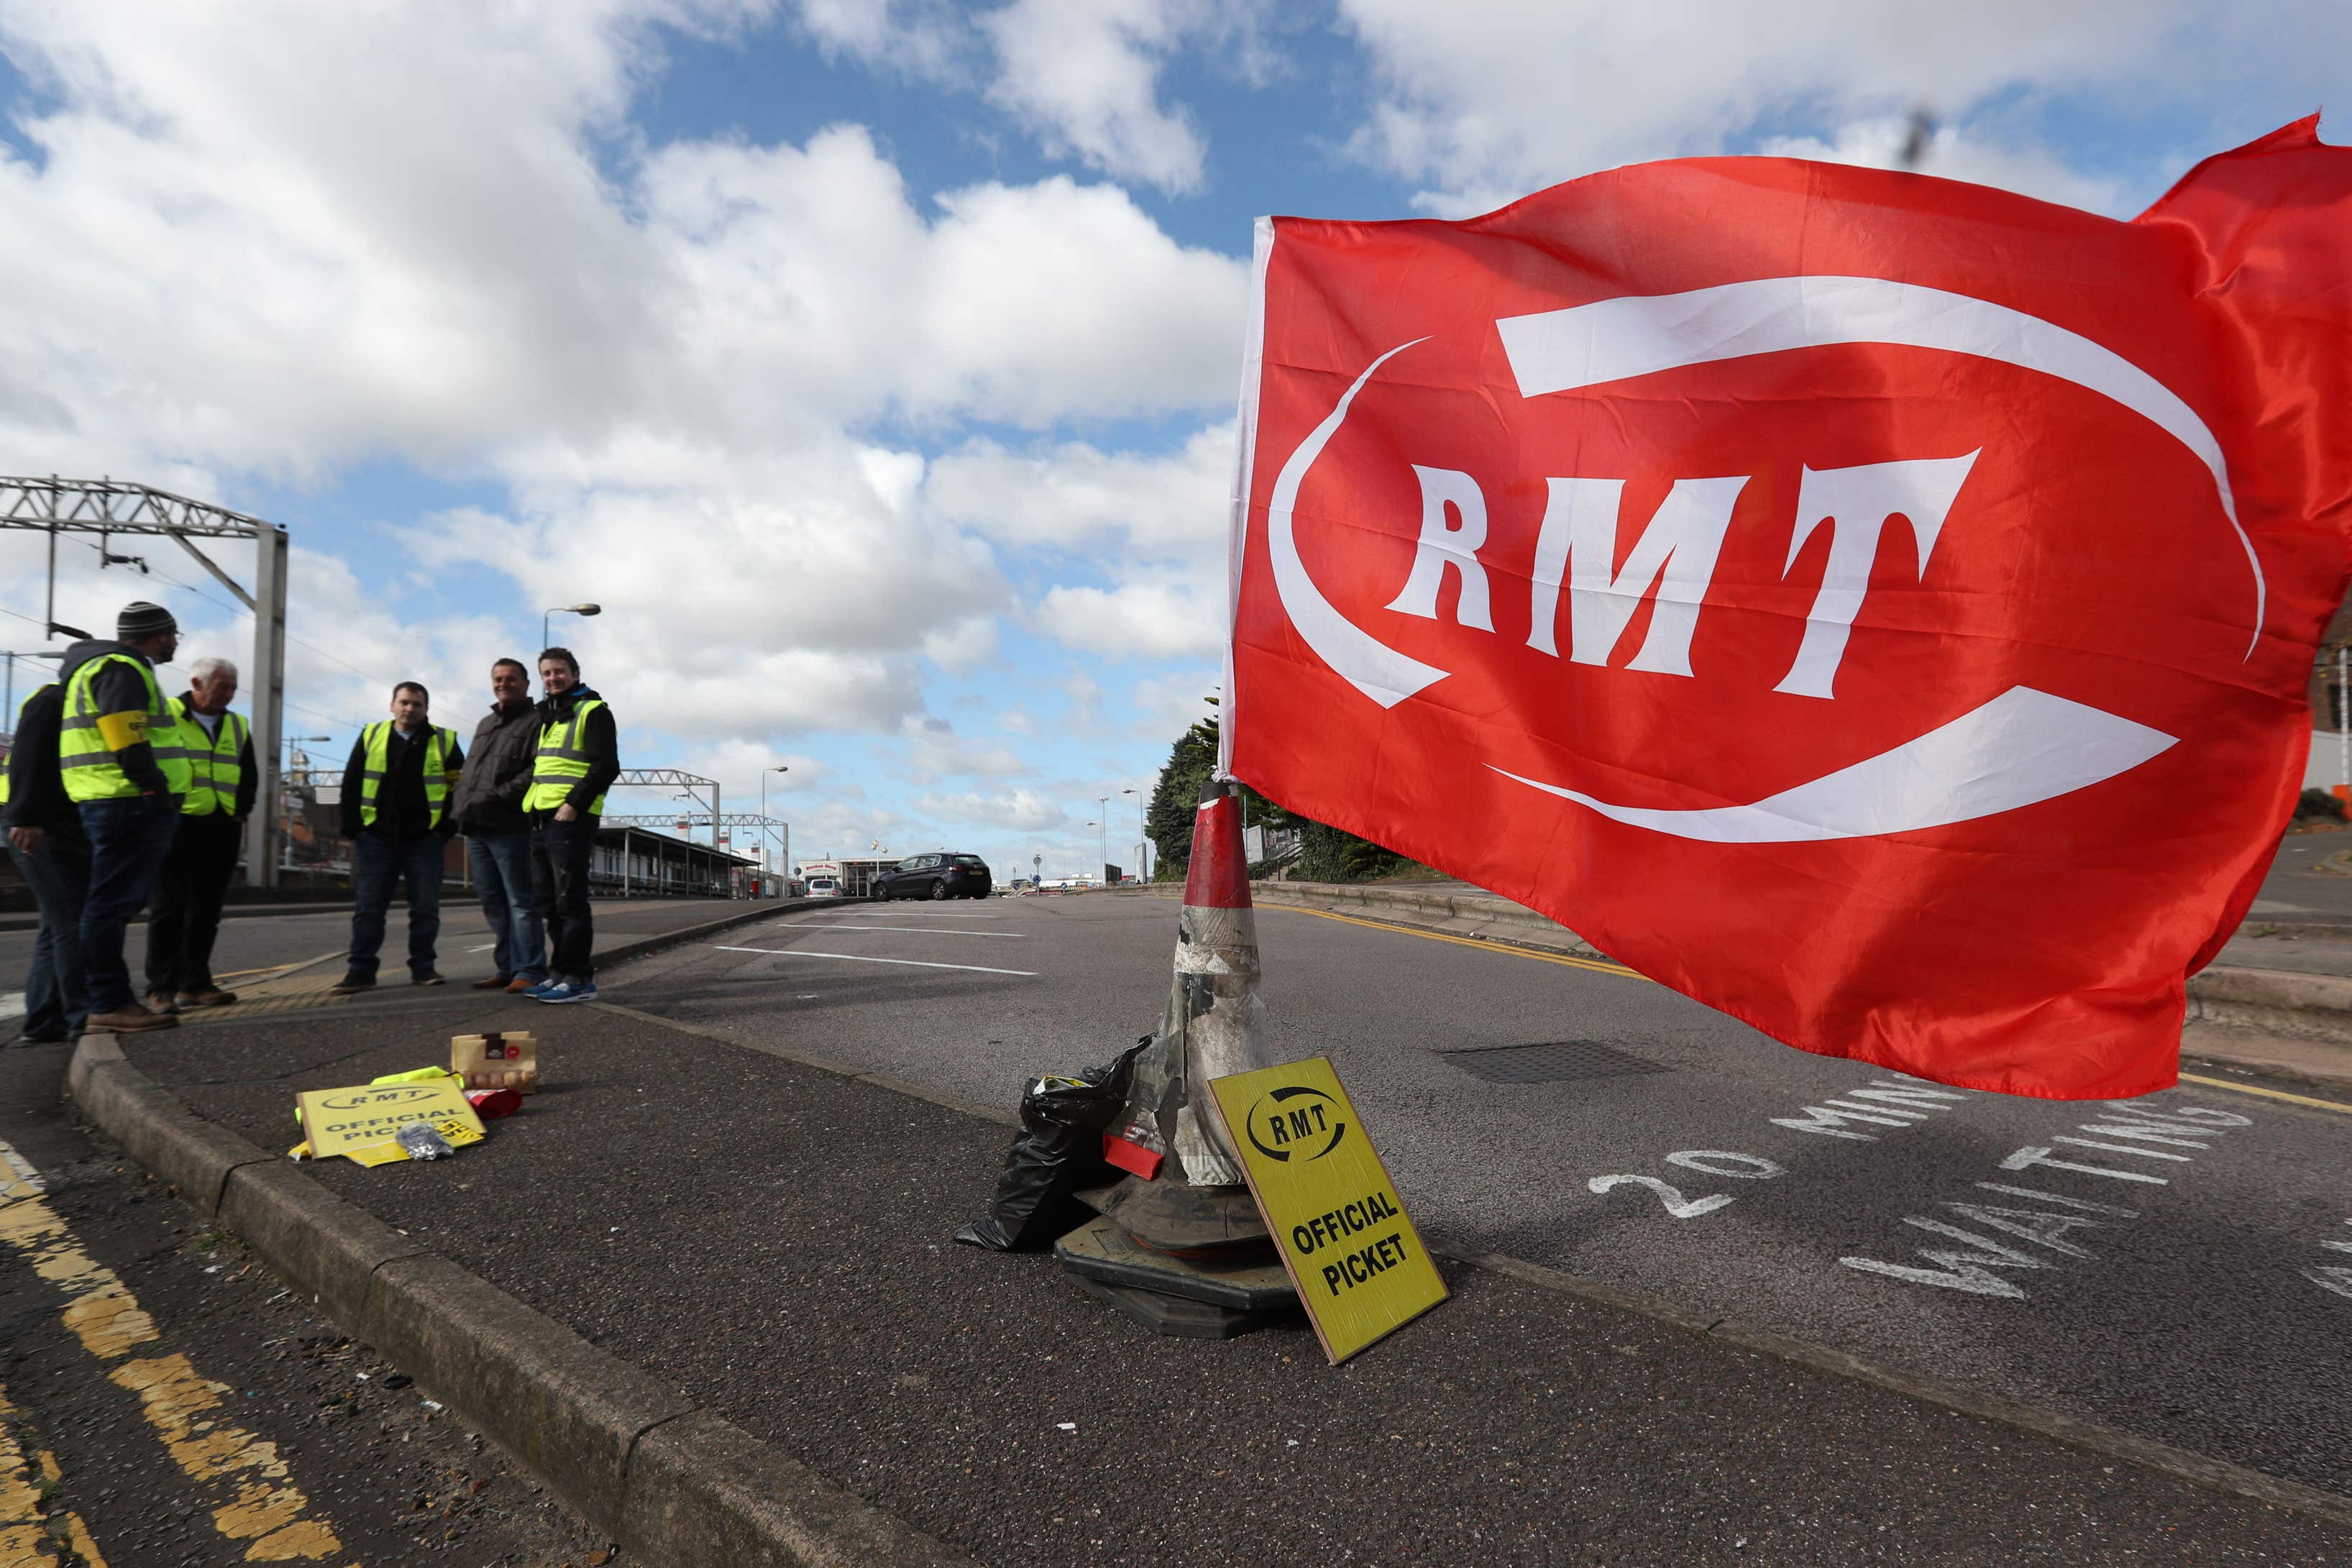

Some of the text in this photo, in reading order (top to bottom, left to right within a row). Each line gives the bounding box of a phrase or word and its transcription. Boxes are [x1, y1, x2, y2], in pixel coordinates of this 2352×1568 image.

[1383, 446, 1983, 700] RMT
[326, 1109, 465, 1132] OFFICIAL
[350, 1090, 421, 1105] RMT
[1268, 1104, 1329, 1146] RMT
[1588, 1150, 1788, 1218] 20
[1839, 1100, 2253, 1299] WAITING
[1293, 1191, 1399, 1255] OFFICIAL
[1322, 1233, 1408, 1296] PICKET
